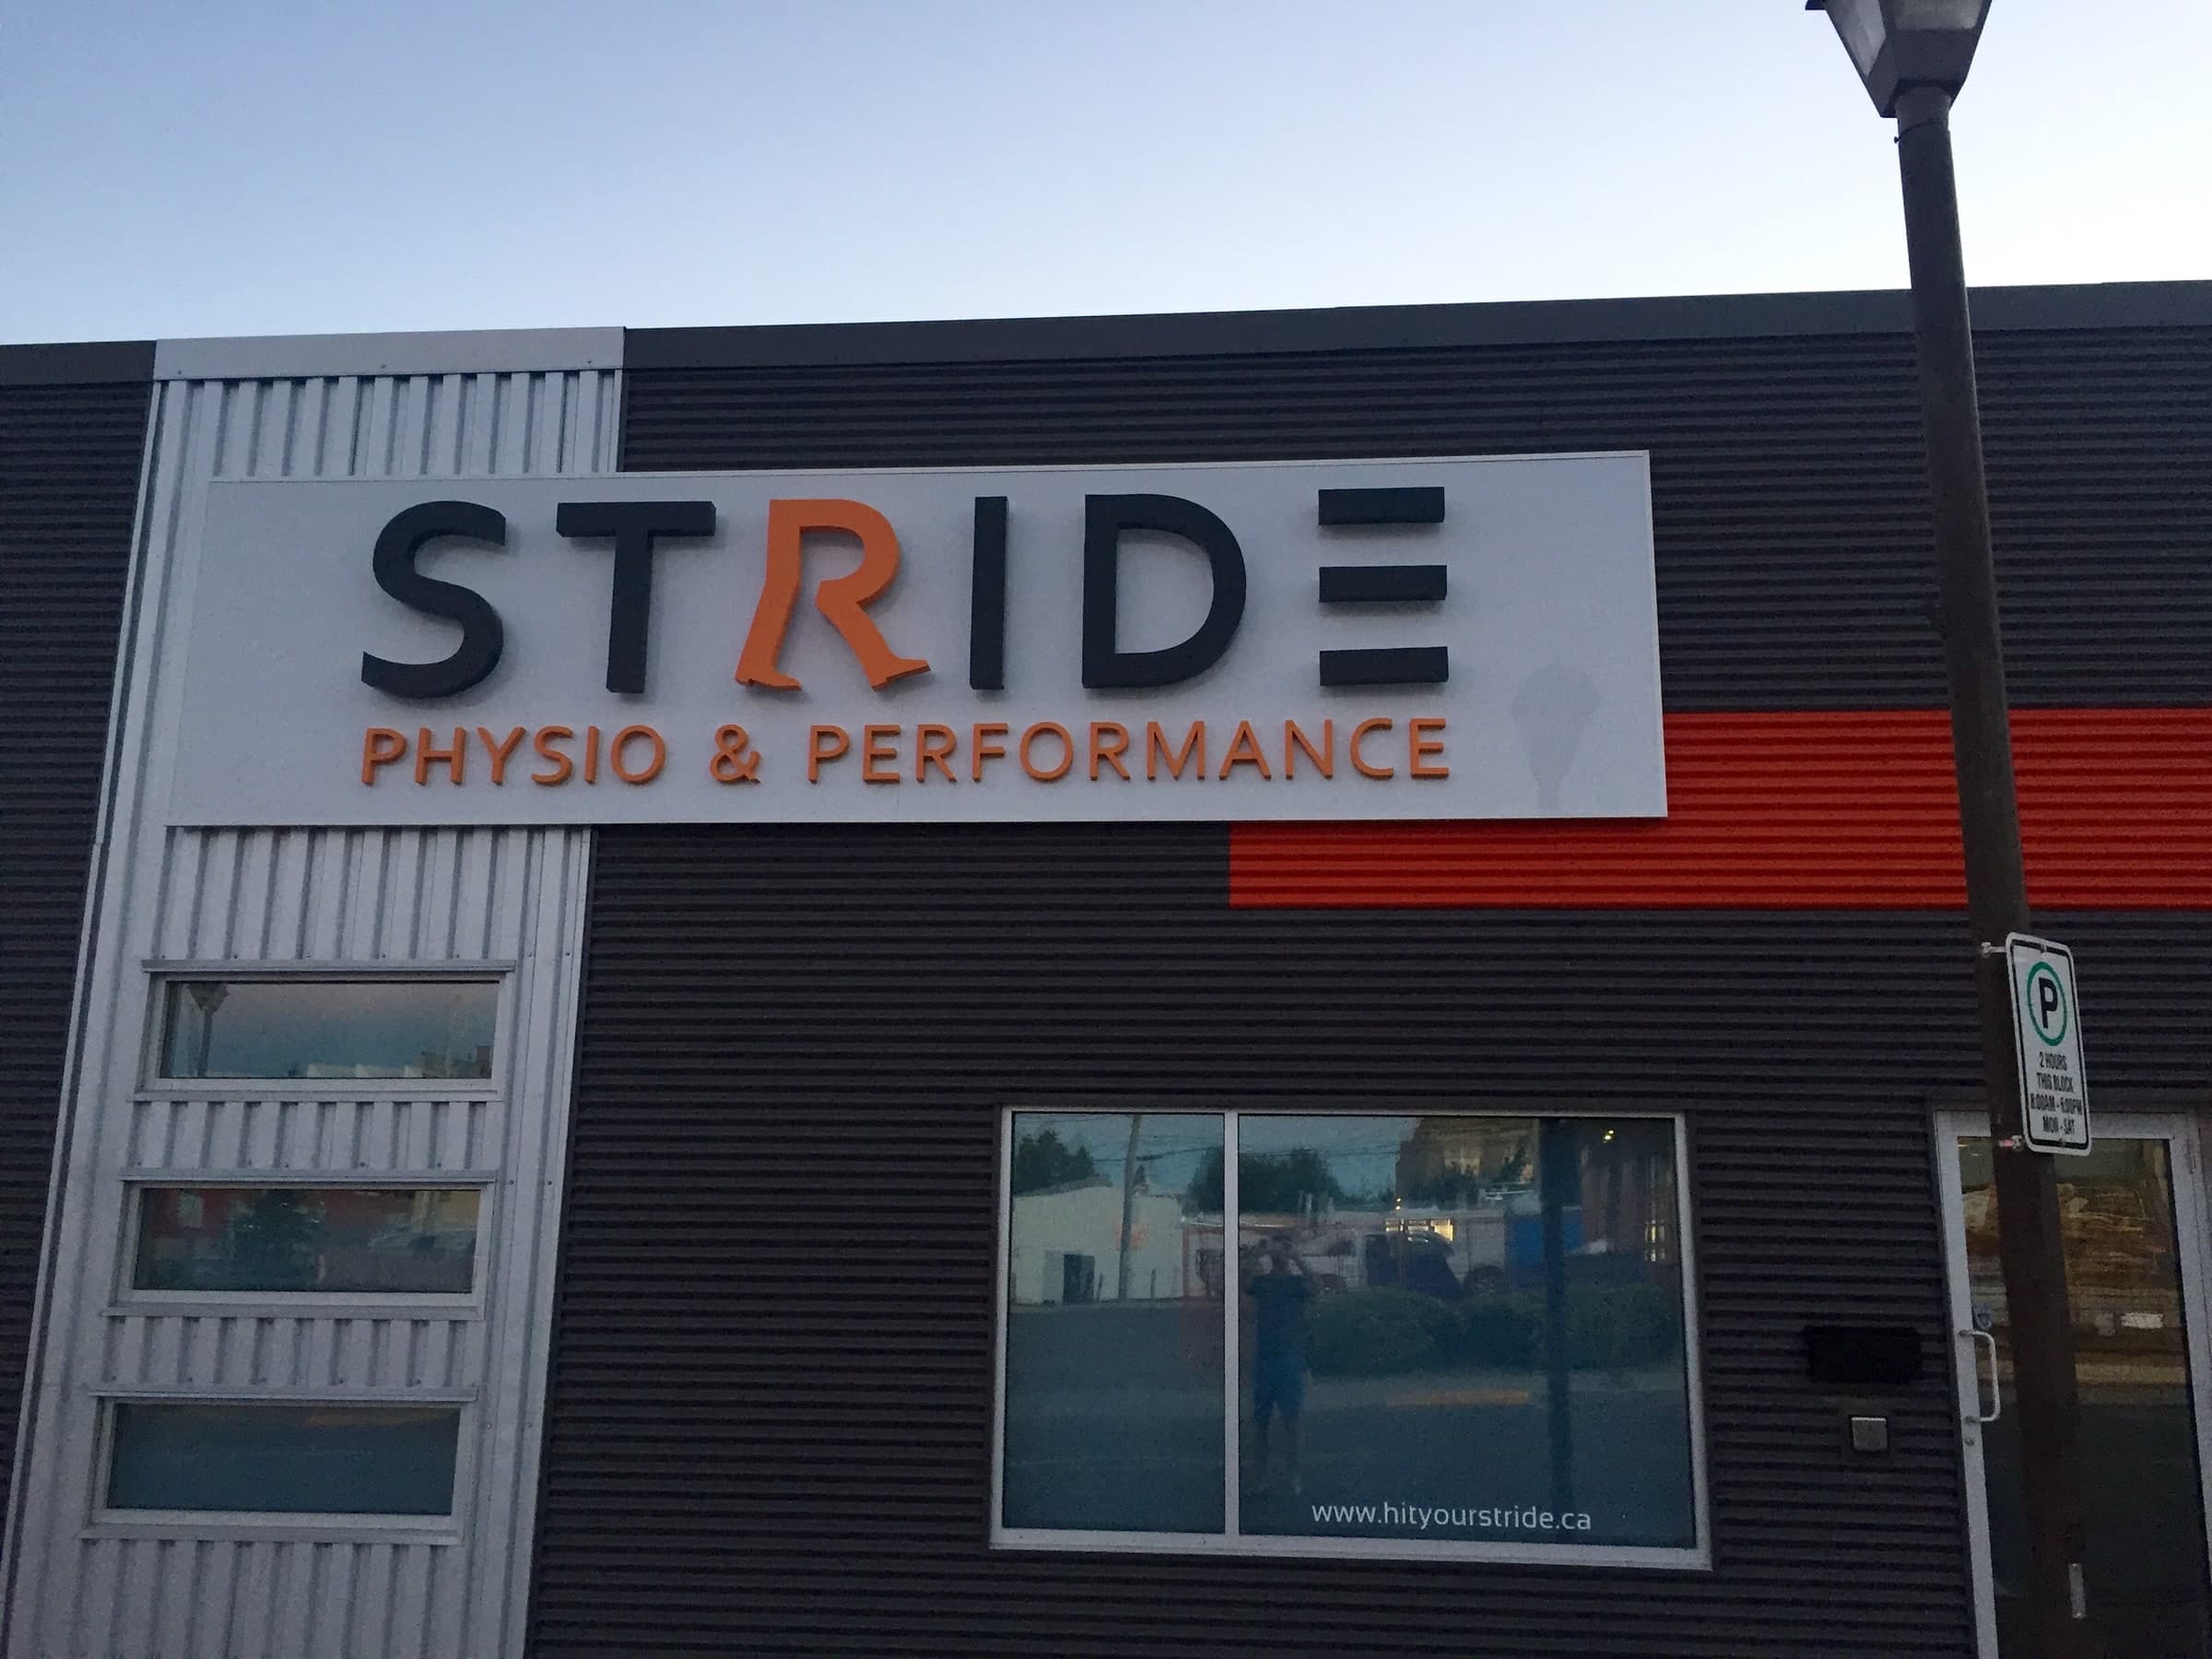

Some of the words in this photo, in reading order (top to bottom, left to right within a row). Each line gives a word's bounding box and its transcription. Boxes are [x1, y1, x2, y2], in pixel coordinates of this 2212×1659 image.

[361, 486, 1449, 699] STRIDE
[360, 724, 666, 786] PHYSIO
[709, 724, 761, 783] &
[807, 717, 1450, 785] PERFORMANCE
[2038, 977, 2058, 1030] P
[2039, 1052, 2044, 1068] 2
[2045, 1053, 2067, 1071] HOURS
[2036, 1072, 2053, 1090] THIS
[2053, 1075, 2074, 1093] BLOCK
[2042, 1116, 2059, 1133] MON
[2064, 1118, 2075, 1135] SAT
[1312, 1500, 1593, 1531] www.hityourstride.ca
